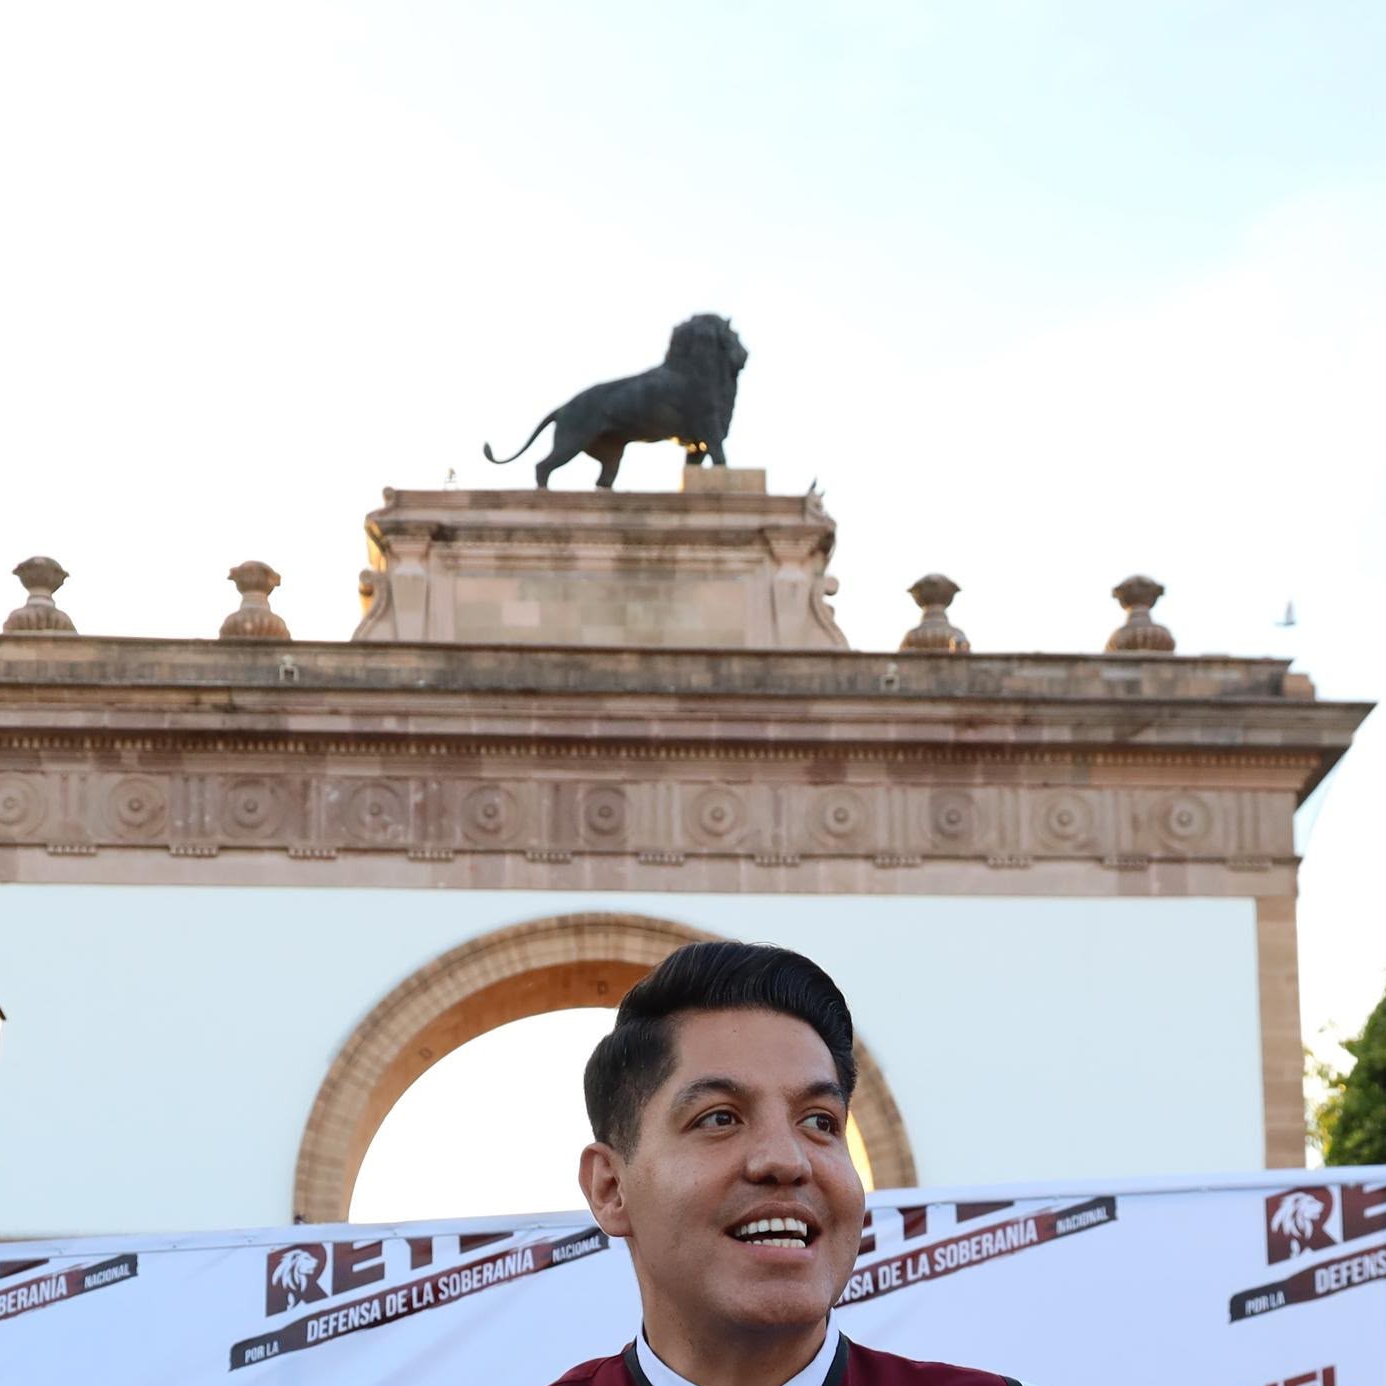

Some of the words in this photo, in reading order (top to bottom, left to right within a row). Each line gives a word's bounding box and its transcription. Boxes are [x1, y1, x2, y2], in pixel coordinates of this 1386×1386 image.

[84, 1263, 129, 1289] NACIONAL
[878, 1261, 902, 1290] DE
[906, 1255, 930, 1281] LA
[934, 1217, 1037, 1272] SOBERANÍA
[1056, 1207, 1109, 1234] NACIONAL
[245, 1344, 265, 1364] POR
[266, 1340, 279, 1355] LA
[307, 1299, 381, 1342] DEFENSA
[385, 1291, 408, 1317] DE
[412, 1284, 433, 1310] LA
[439, 1247, 534, 1300] SOBERANÍA
[552, 1237, 602, 1263] NACIONAL
